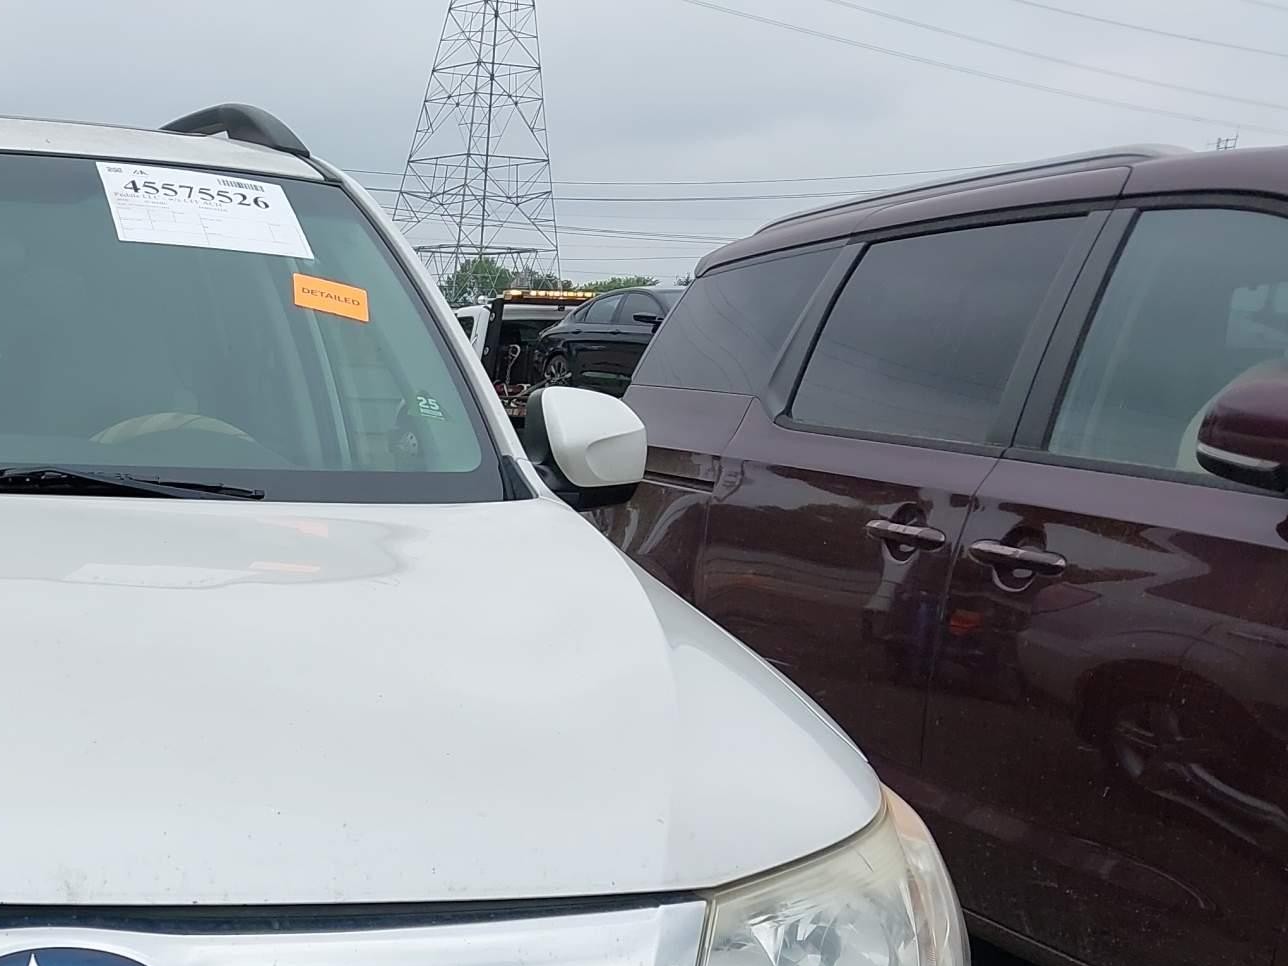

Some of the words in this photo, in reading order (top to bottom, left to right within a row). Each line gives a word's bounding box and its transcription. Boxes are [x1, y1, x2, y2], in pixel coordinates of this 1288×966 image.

[123, 179, 270, 209] 45575526
[301, 287, 360, 306] DETAILED
[416, 396, 440, 411] 25
